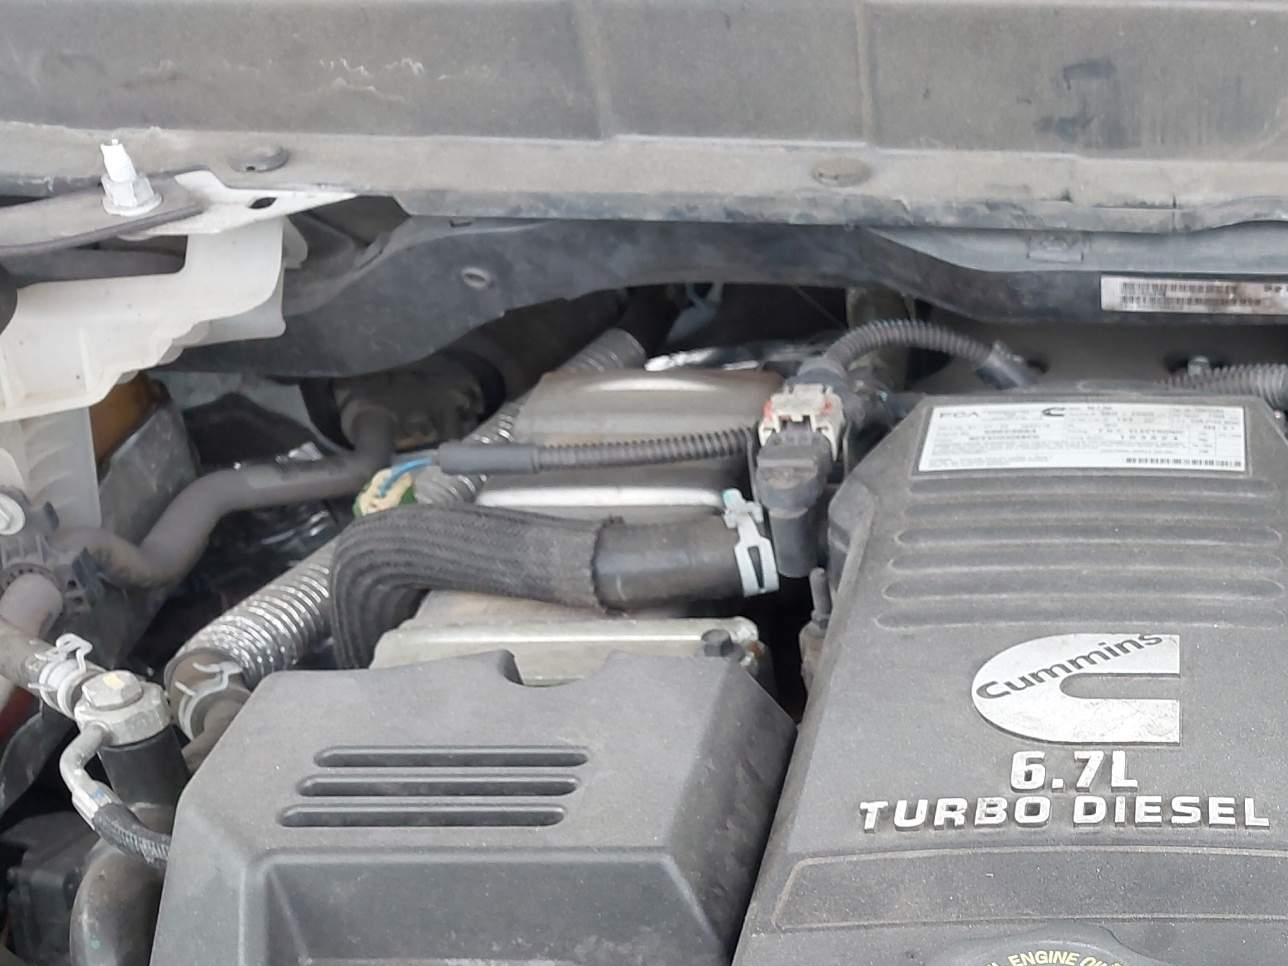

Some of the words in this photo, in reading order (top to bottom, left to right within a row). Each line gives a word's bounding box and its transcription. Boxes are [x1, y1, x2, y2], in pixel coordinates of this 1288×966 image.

[975, 633, 1163, 699] Cummins
[1009, 750, 1138, 793] 6.7L
[859, 797, 1051, 834] TURBO
[1072, 796, 1271, 830] DIESEL
